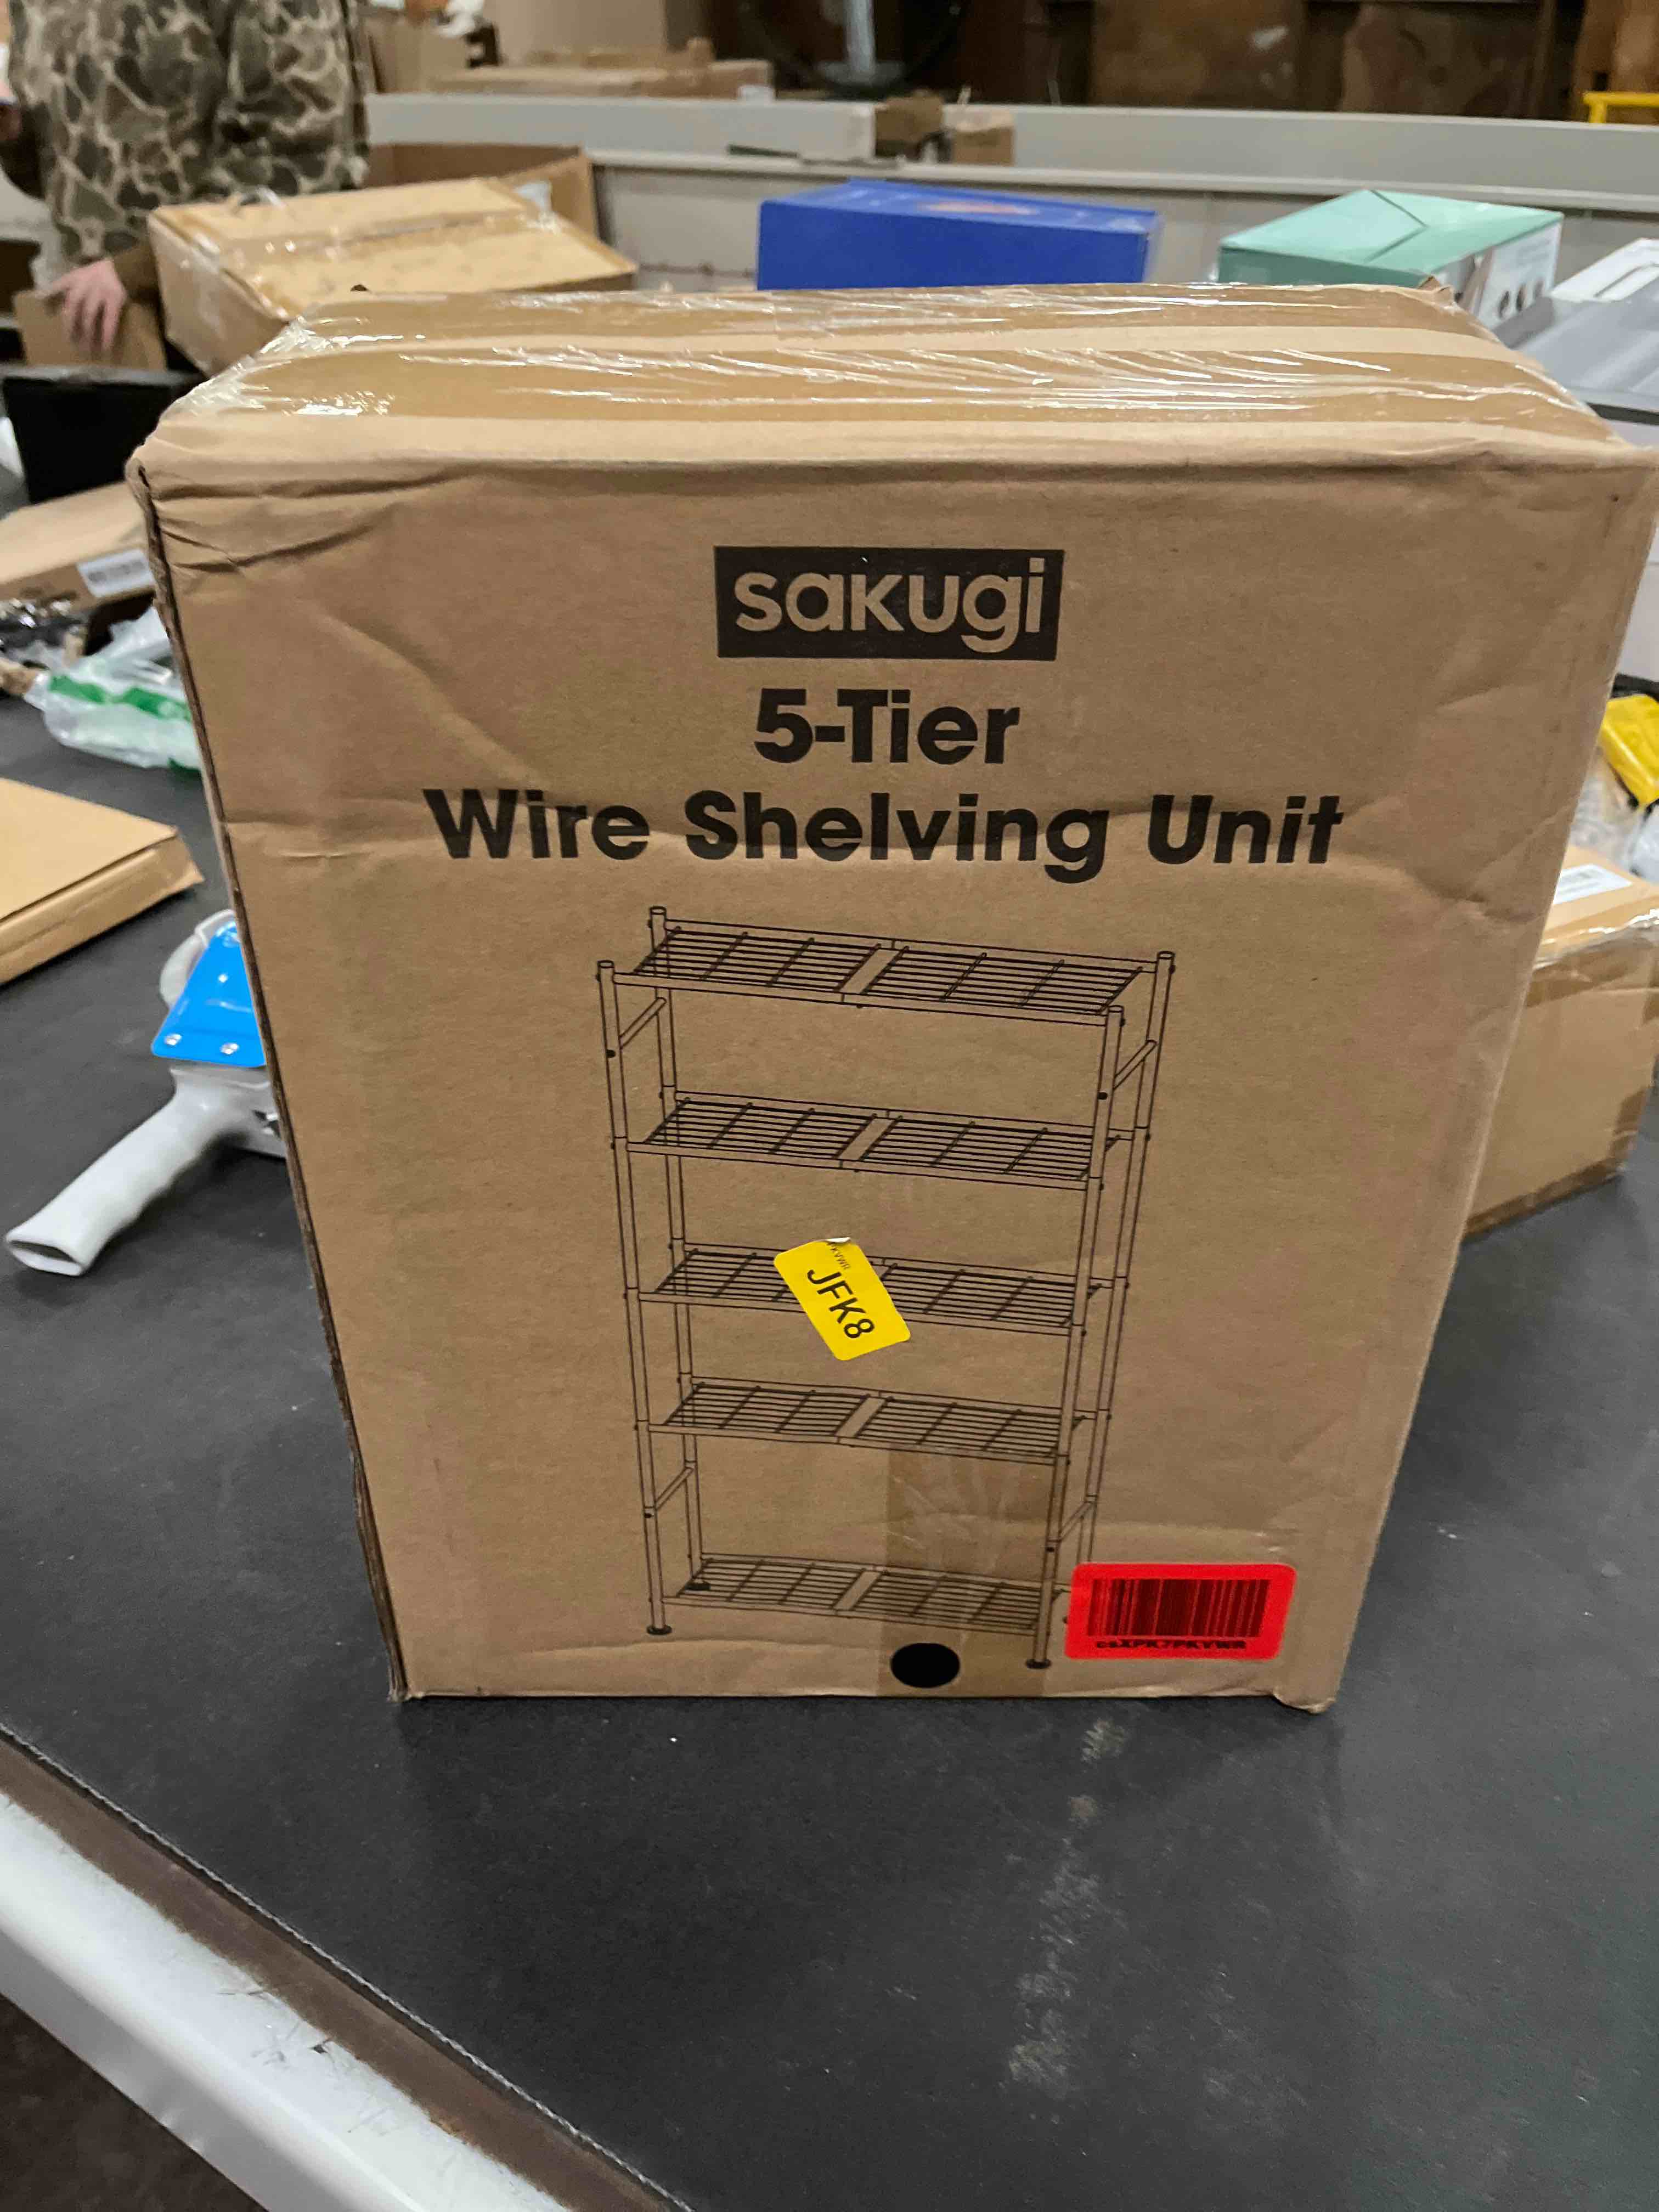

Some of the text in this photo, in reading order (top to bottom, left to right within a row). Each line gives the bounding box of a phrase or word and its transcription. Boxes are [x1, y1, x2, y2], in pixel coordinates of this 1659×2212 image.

[734, 556, 1045, 653] sakugi
[754, 687, 1020, 765] 5-Tier
[422, 788, 1345, 884] Wire Shelving Unit
[806, 1268, 876, 1339] JFK8
